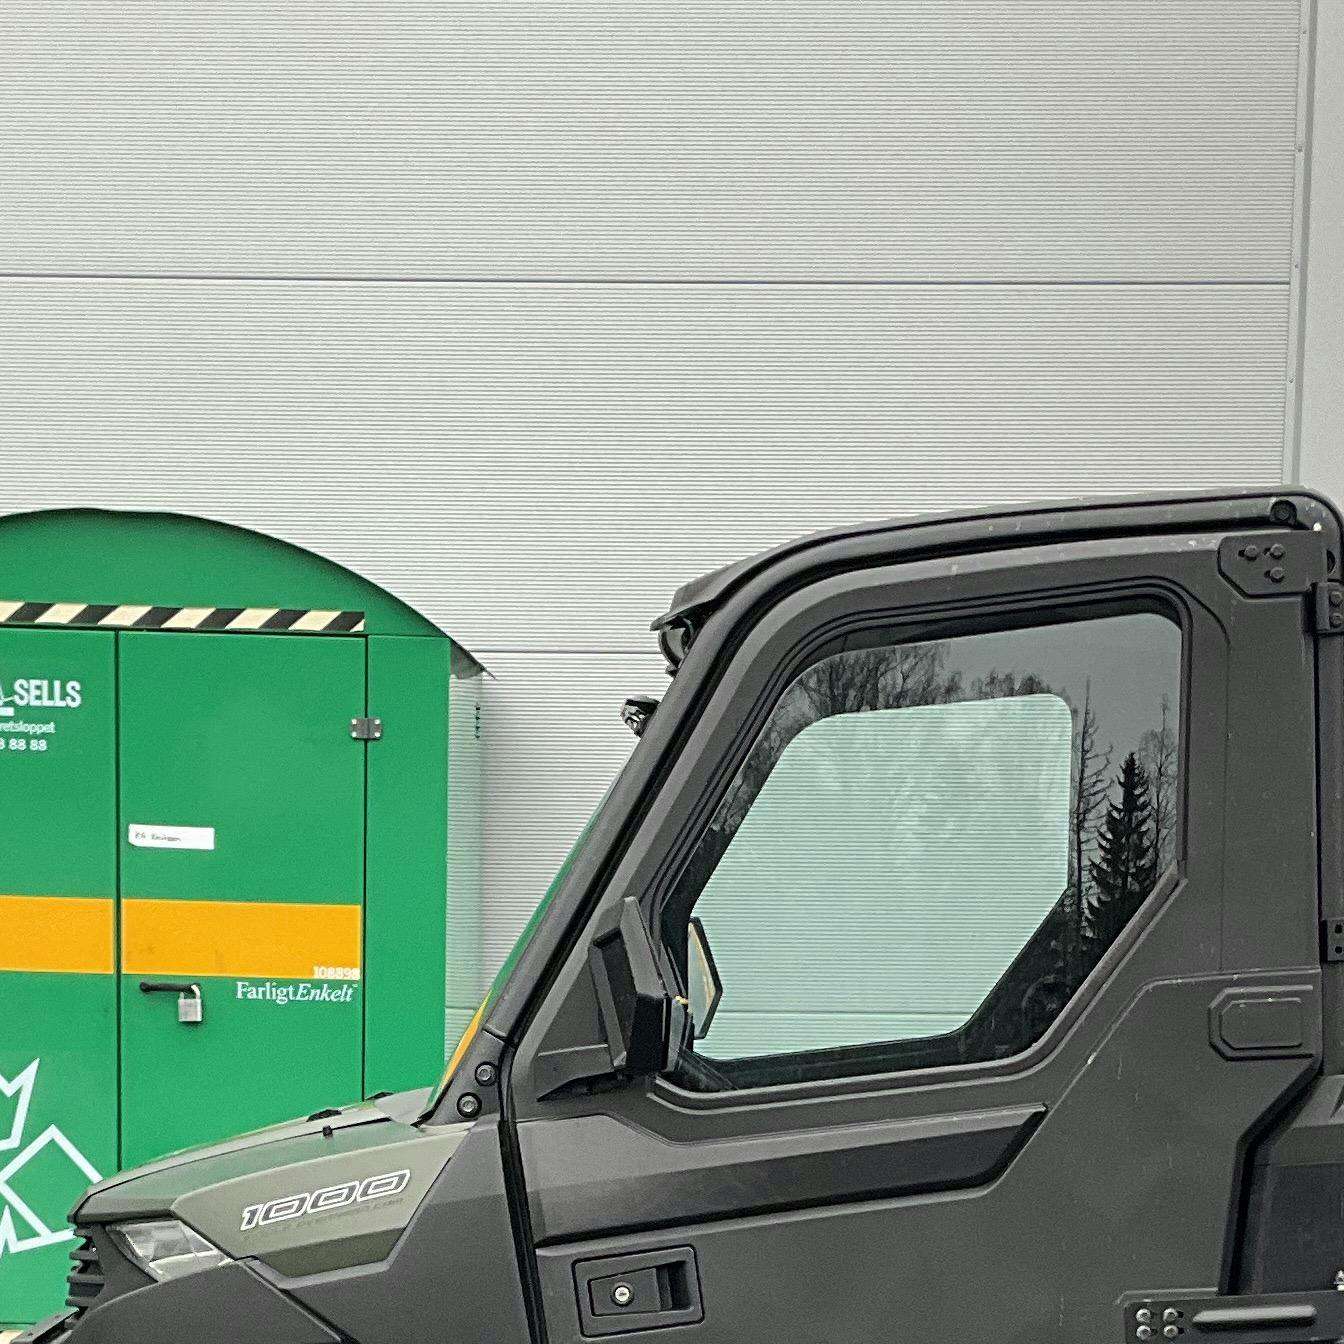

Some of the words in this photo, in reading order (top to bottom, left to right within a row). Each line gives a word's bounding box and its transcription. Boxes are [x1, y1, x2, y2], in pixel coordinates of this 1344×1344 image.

[13, 679, 82, 708] SELLS
[8, 738, 27, 751] 88
[29, 739, 48, 751] 88
[241, 1169, 411, 1231] 1000
